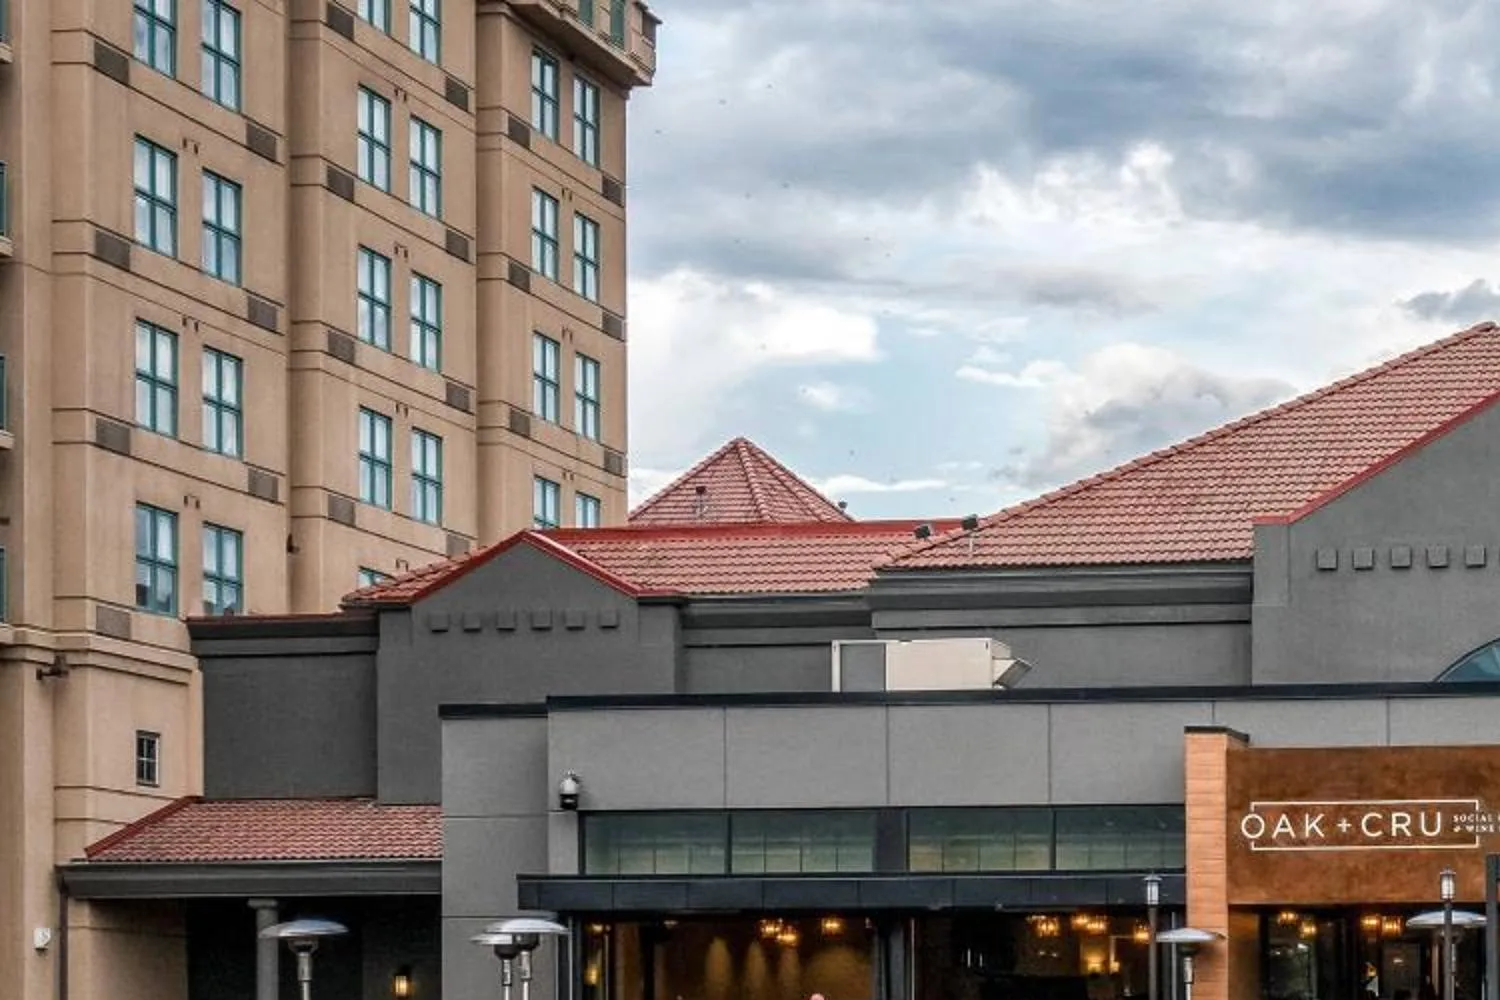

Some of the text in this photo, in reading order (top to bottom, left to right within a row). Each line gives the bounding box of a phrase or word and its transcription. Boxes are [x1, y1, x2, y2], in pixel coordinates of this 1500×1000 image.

[1453, 813, 1493, 823] SOCIAL
[1241, 813, 1325, 839] OAK
[1361, 811, 1441, 838] CRU
[1465, 823, 1495, 833] WINE
